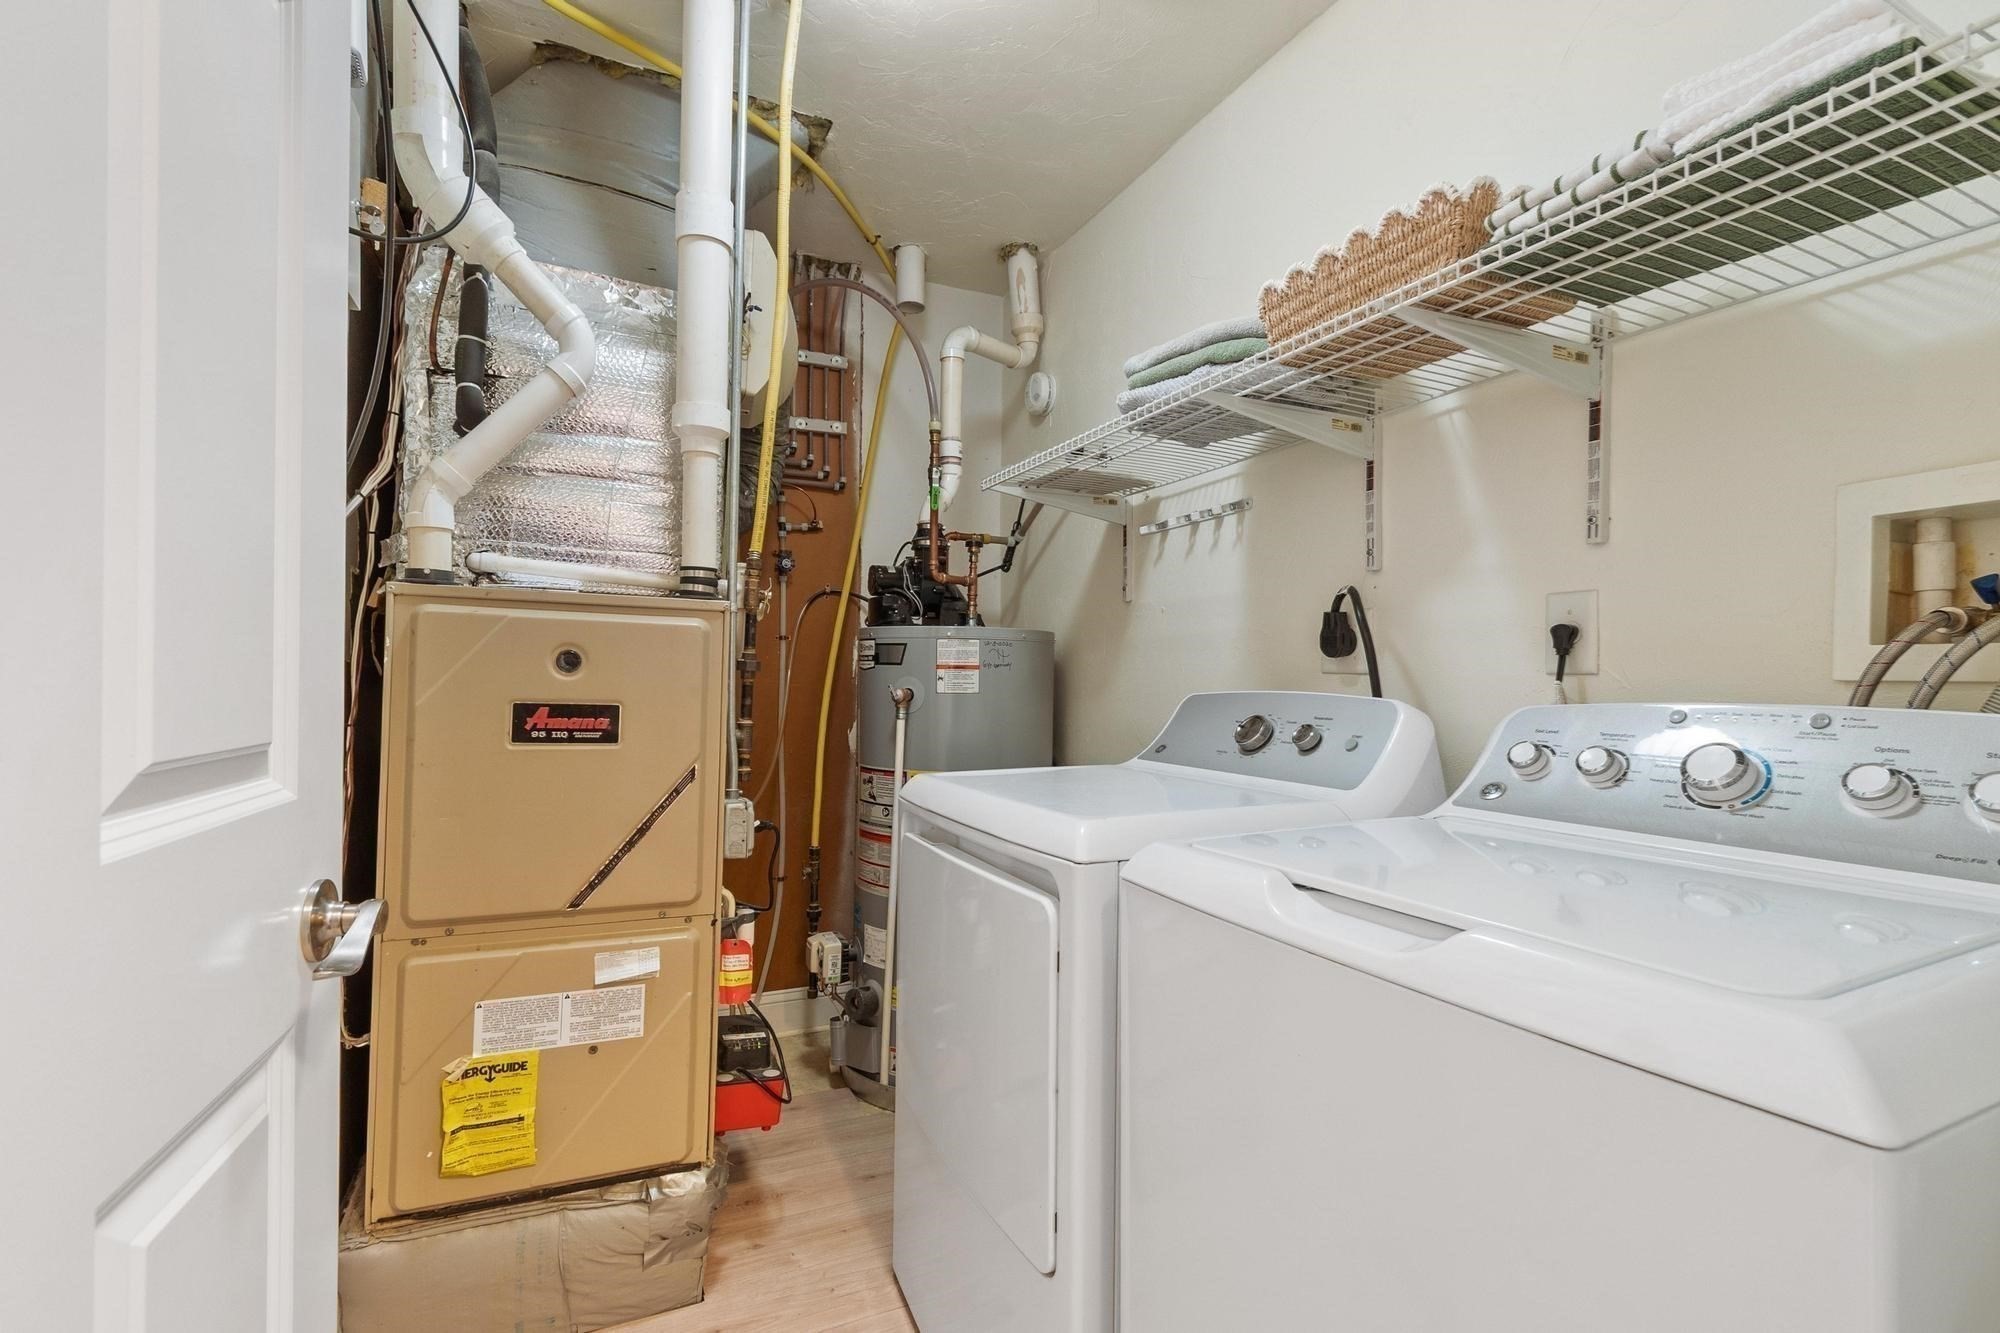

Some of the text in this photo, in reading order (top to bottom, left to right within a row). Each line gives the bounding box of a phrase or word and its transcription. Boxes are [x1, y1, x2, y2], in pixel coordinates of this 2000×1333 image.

[524, 706, 610, 730] Amana
[1599, 731, 1636, 739] Temperature
[1874, 745, 1910, 755] Options
[447, 1060, 528, 1084] ERGYGUIDE
